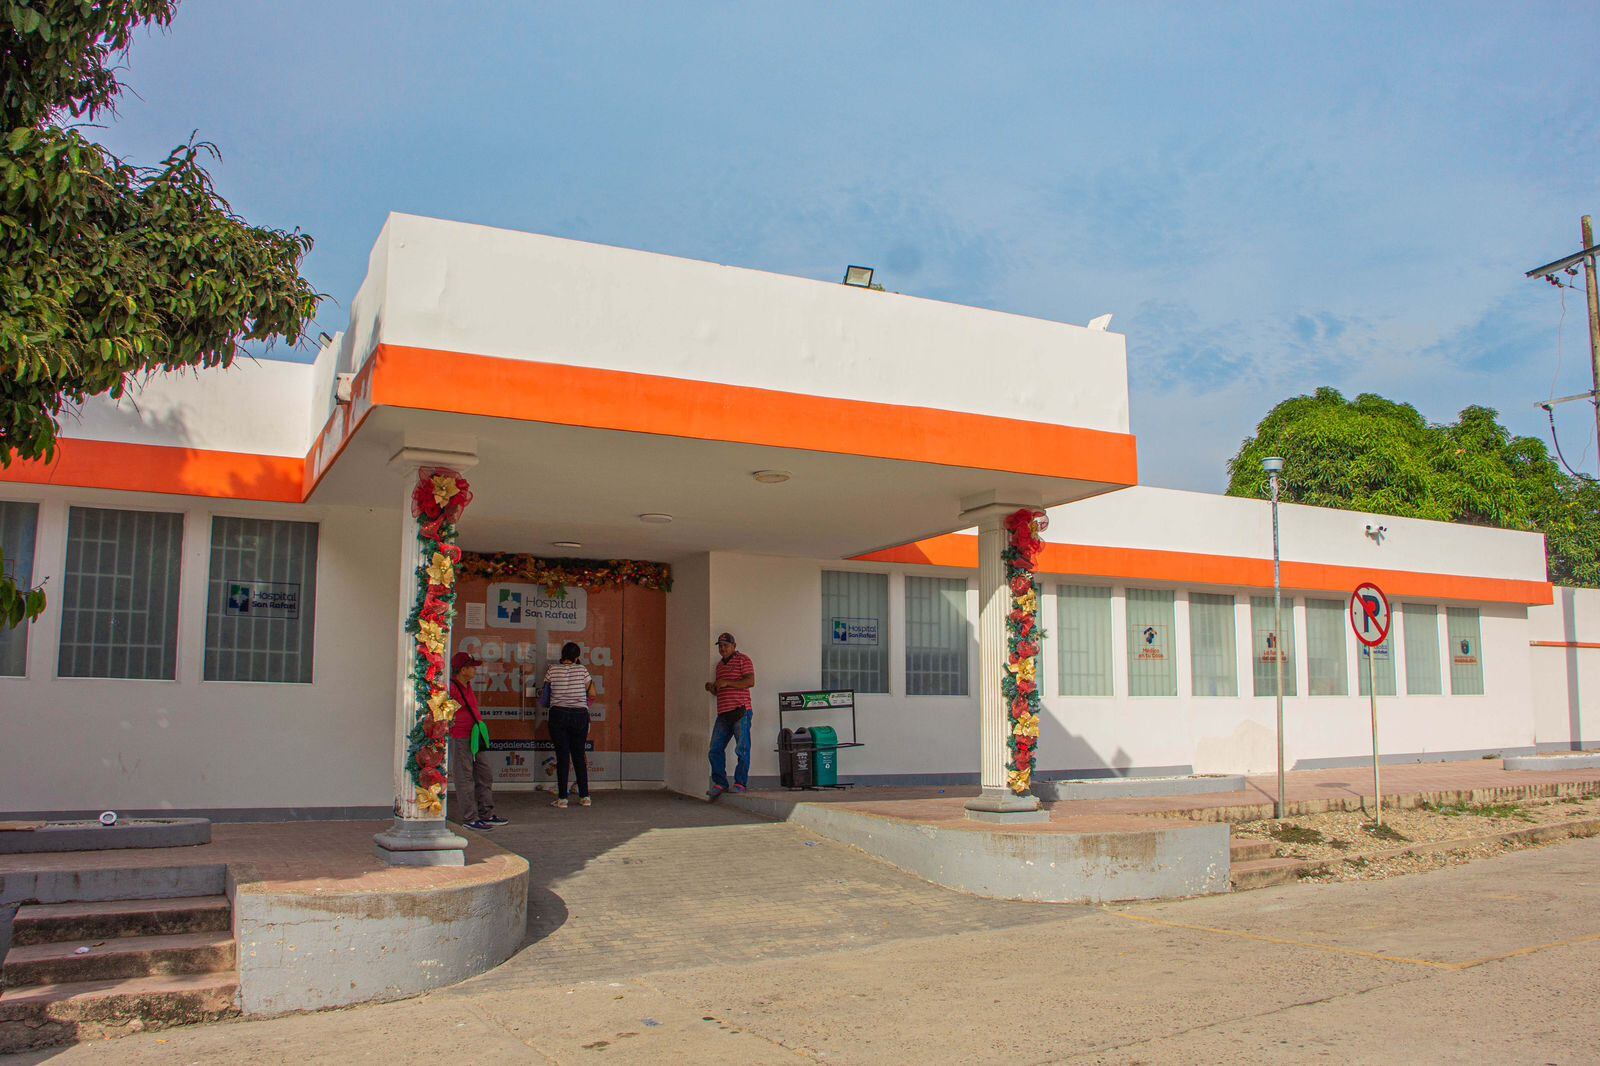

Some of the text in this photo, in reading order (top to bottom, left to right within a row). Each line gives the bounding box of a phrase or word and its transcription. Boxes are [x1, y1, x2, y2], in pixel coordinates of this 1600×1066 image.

[253, 590, 297, 602] Hospital
[252, 600, 296, 610] San Rafael
[526, 596, 577, 610] Hospital
[525, 609, 577, 620] San Rafael
[848, 624, 876, 634] Hospital
